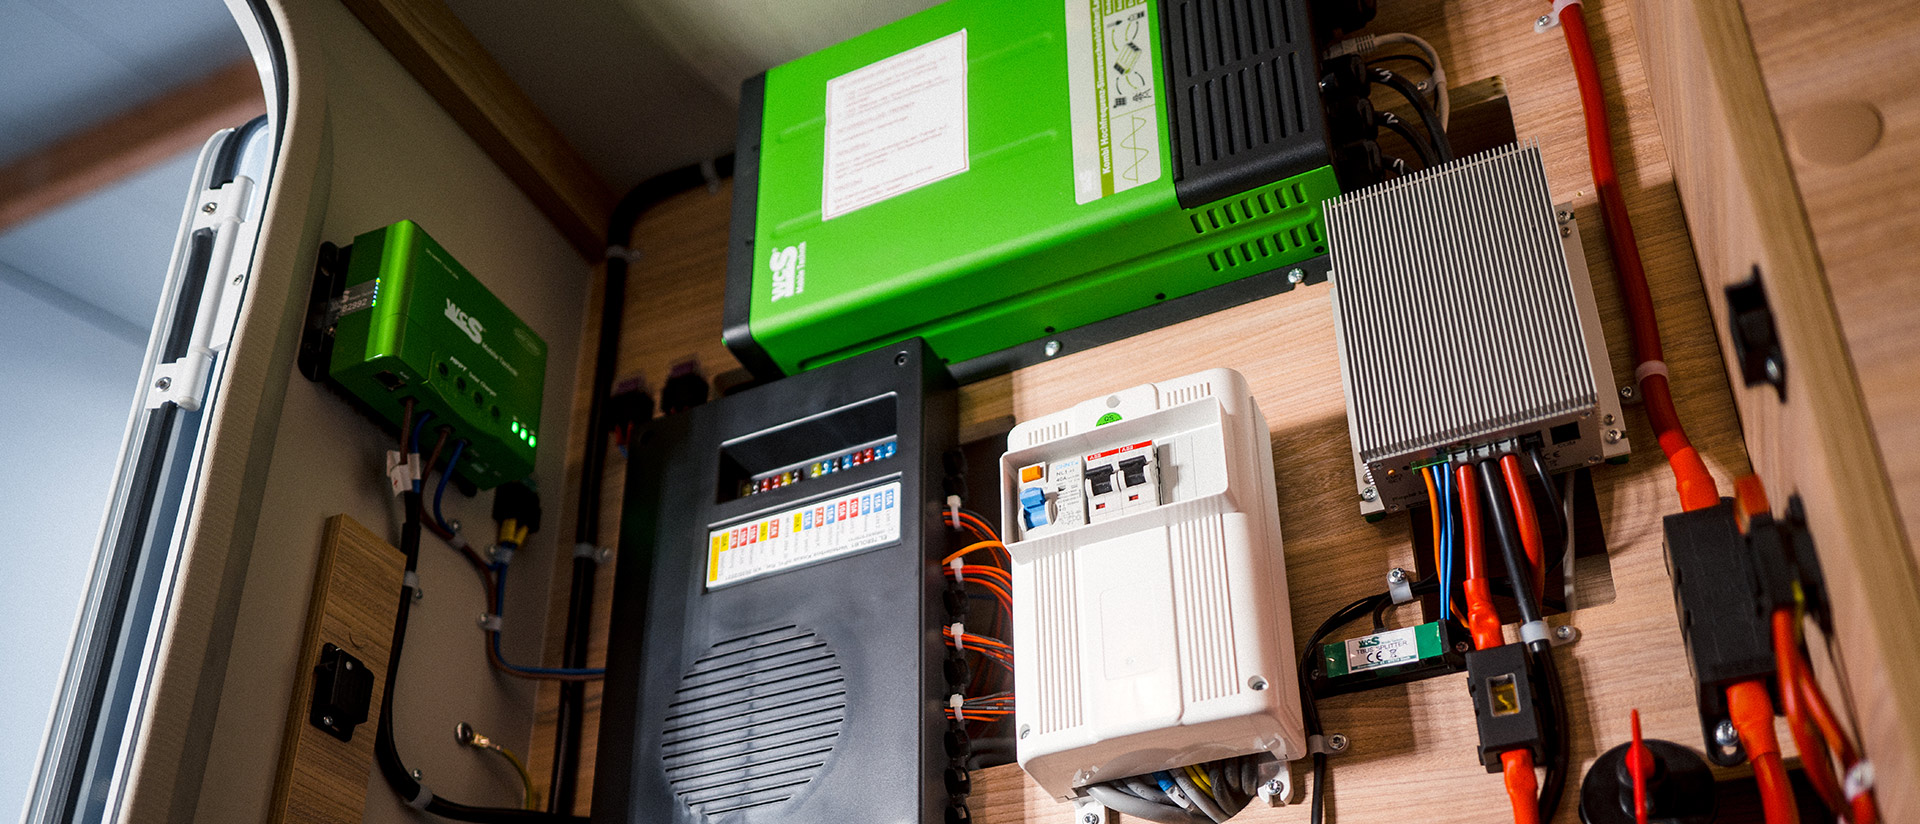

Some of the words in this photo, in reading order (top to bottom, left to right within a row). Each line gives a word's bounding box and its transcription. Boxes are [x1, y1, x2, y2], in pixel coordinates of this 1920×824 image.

[1383, 111, 1399, 124] 2
[1102, 152, 1112, 174] Kombi
[1375, 640, 1408, 651] SPLITTER
